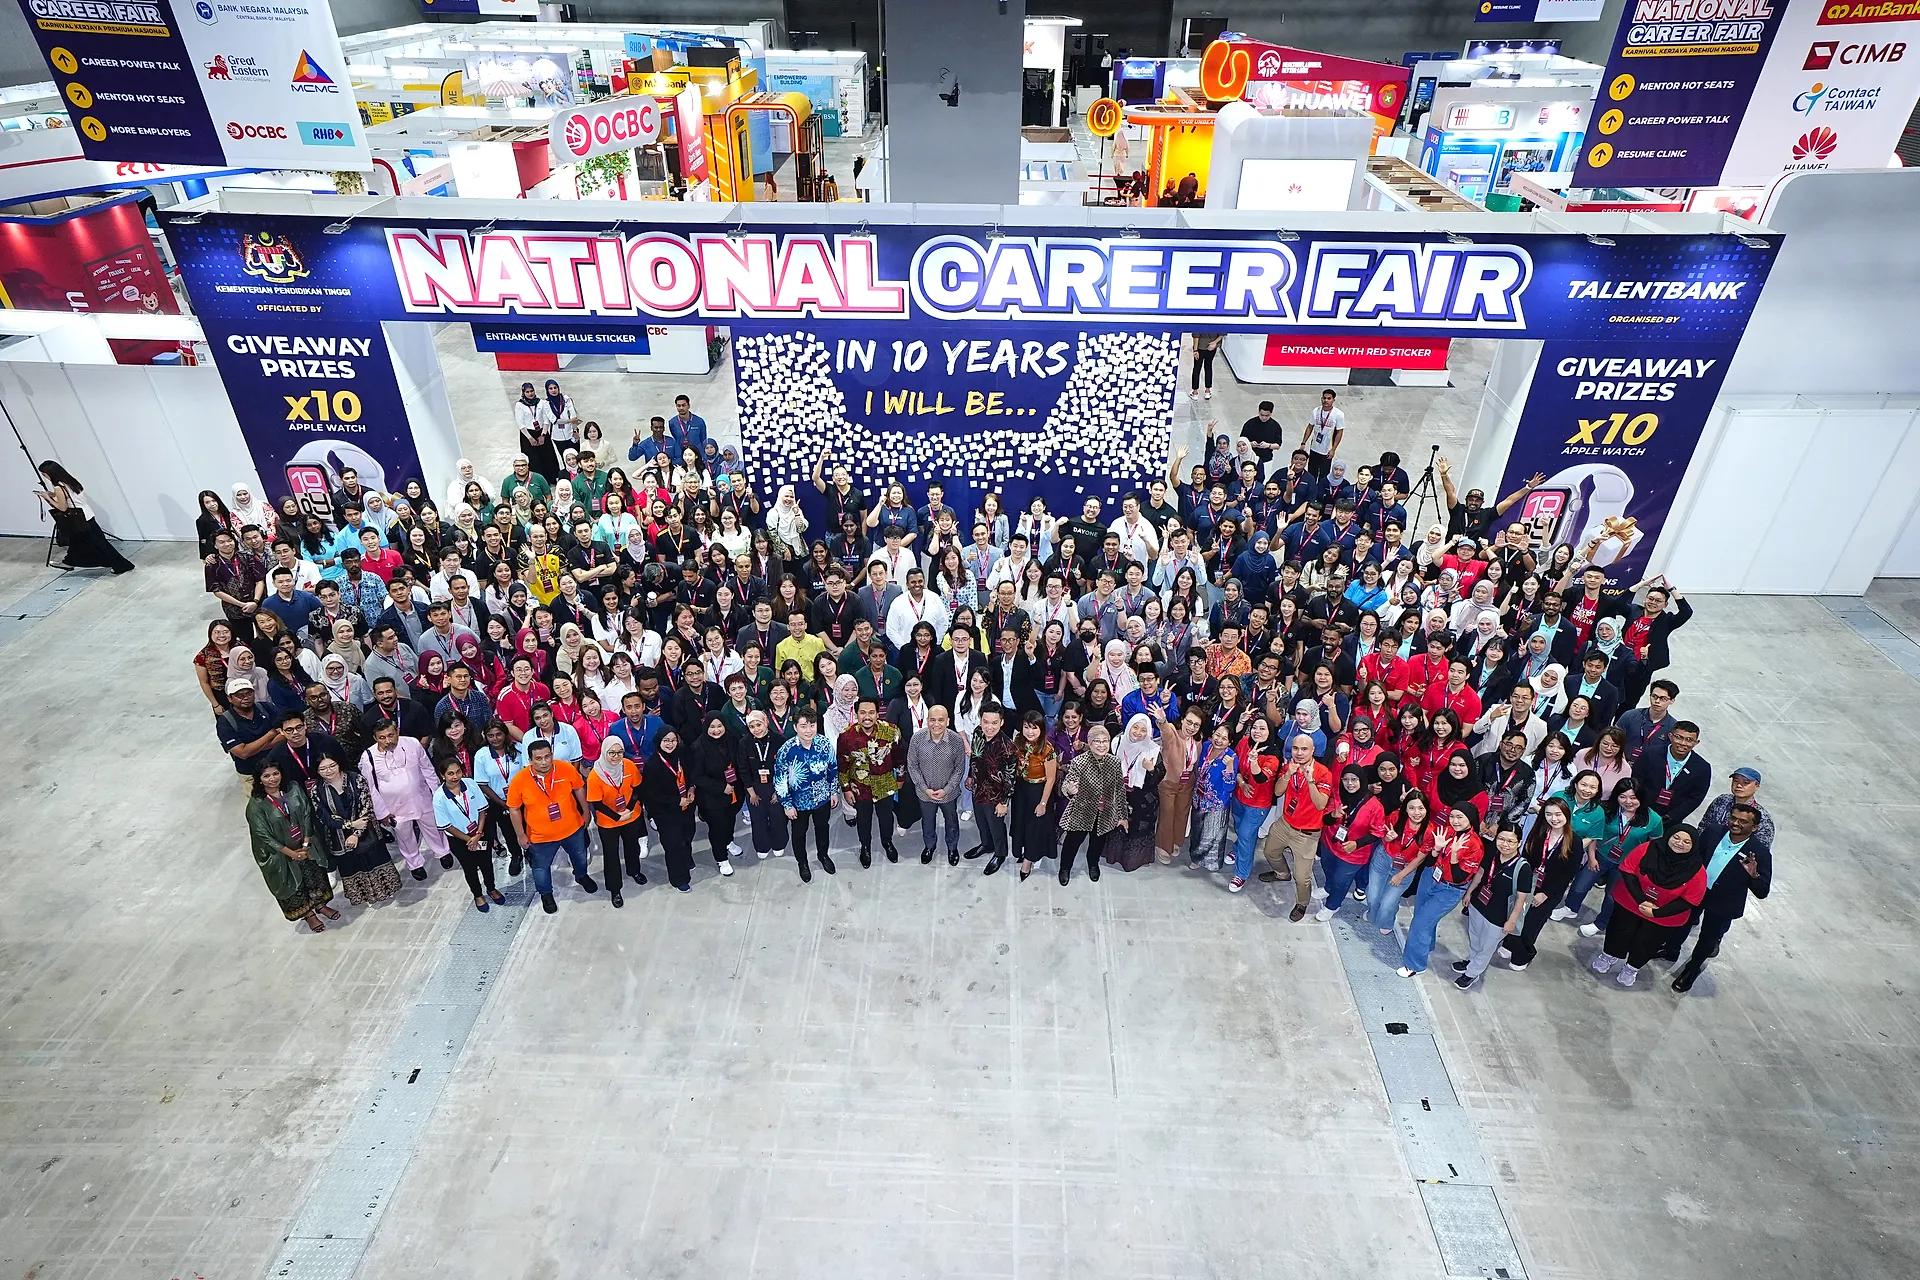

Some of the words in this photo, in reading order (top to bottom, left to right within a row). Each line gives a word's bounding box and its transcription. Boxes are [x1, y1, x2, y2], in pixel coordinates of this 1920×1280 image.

[29, 0, 113, 21] CAREER
[112, 3, 165, 25] FAIR
[217, 4, 239, 12] BANK
[240, 5, 271, 14] NEGARA
[273, 7, 309, 16] MALAYSIA
[1633, 0, 1775, 23] NATIONAL
[40, 21, 74, 30] KARNIVAL
[73, 23, 102, 31] KERJAYA
[103, 25, 134, 33] PREMIUM
[133, 27, 167, 35] NASIONAL
[1627, 24, 1714, 46] CAREER
[1713, 21, 1764, 42] FAIR
[629, 41, 642, 53] RHB
[1839, 42, 1907, 65] CIMB
[81, 57, 119, 68] CAREER
[120, 59, 156, 70] POWER
[156, 61, 181, 71] TALK
[227, 54, 256, 67] Great
[230, 66, 270, 77] Eastern
[290, 84, 339, 94] MCMC
[644, 79, 687, 89] Mbank
[1639, 81, 1680, 91] MENTOR
[1681, 81, 1702, 90] HOT
[1703, 80, 1735, 90] SEATS
[95, 92, 135, 102] MENTOR
[136, 94, 156, 104] HOT
[157, 95, 185, 105] SEATS
[1828, 86, 1882, 99] Contact
[1289, 92, 1372, 111] HUAWEI
[1824, 100, 1877, 111] TAIWAN
[593, 105, 654, 145] OCBC
[1628, 117, 1666, 125] CAREER
[1666, 116, 1703, 125] POWER
[1704, 115, 1730, 124] TALK
[110, 125, 137, 136] MORE
[138, 127, 191, 138] EMPLOYERS
[245, 124, 287, 140] OCBC
[313, 128, 335, 140] RHB
[1617, 150, 1656, 159] RESUME
[1657, 150, 1687, 158] CLINIC
[387, 231, 908, 318] NATIONAL
[911, 235, 1298, 324] CAREER
[1299, 241, 1534, 329] FAIR
[215, 285, 273, 294] KEMENTERIAN
[274, 286, 322, 295] PENDIDIKAN
[323, 288, 351, 296] TINGGI
[1567, 280, 1746, 300] TALENTBANK
[256, 304, 308, 313] OFFICIATED
[310, 305, 322, 313] BY
[1608, 315, 1664, 323] ORGANISED
[485, 332, 538, 342] ENTRANCE
[539, 333, 566, 342] WITH
[568, 334, 594, 343] BLUE
[595, 334, 636, 343] STICKER
[227, 334, 372, 357] GIVEAWAY
[1280, 345, 1335, 355] ENTRANCE
[1337, 346, 1364, 356] WITH
[1366, 347, 1388, 356] RED
[1389, 347, 1432, 357] STICKER
[834, 338, 874, 374] IN
[892, 339, 928, 374] 10
[943, 339, 1071, 379] YEARS
[259, 358, 356, 379] PRIZES
[1556, 357, 1717, 378] GIVEAWAY
[1574, 381, 1677, 401] PRIZES
[283, 389, 362, 423] x10
[864, 390, 873, 416] I
[884, 390, 954, 416] WILL
[964, 391, 1037, 416] BE...
[288, 423, 324, 432] APPLE
[325, 423, 367, 433] WATCH
[1564, 412, 1659, 446] x10
[1560, 446, 1600, 456] APPLE
[1602, 447, 1647, 457] WATCH
[291, 471, 323, 494] 10
[1528, 495, 1561, 518] 10
[1072, 526, 1099, 537] DAYONE
